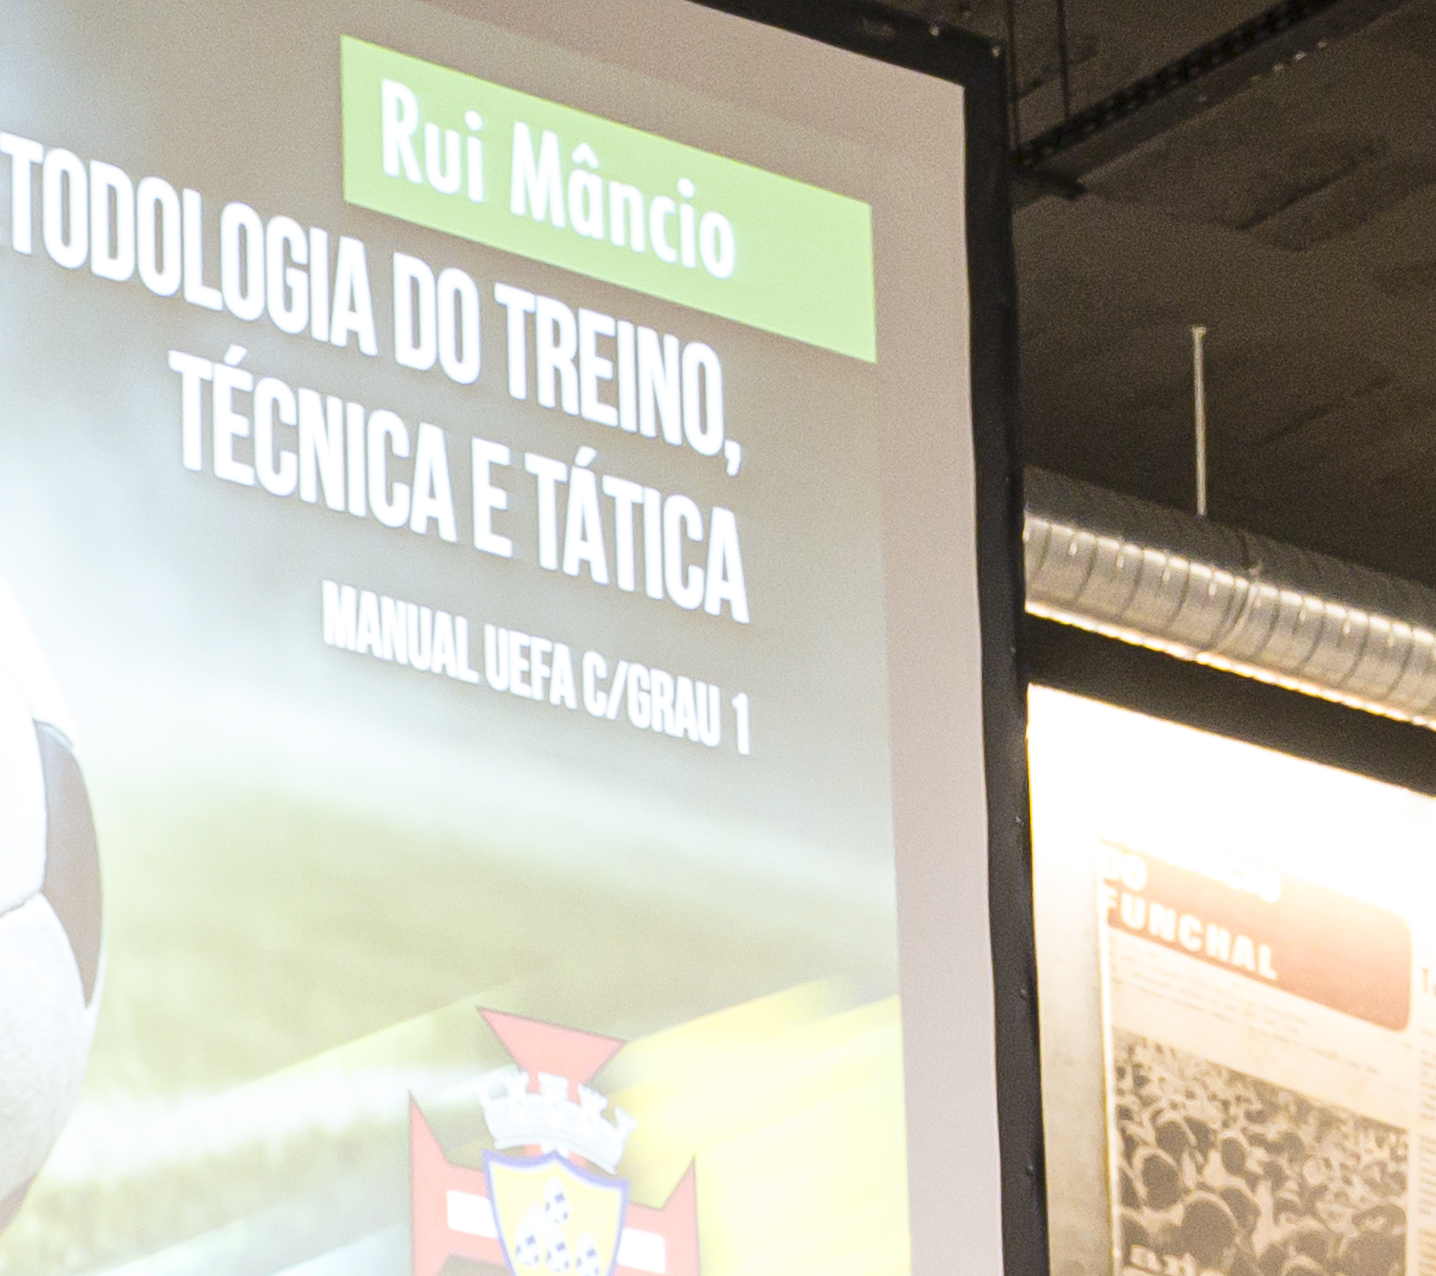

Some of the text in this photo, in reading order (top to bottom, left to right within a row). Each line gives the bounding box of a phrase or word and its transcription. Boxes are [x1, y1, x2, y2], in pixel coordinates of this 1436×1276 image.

[380, 78, 738, 281] Rui Mâncio
[391, 250, 482, 387] DO
[493, 280, 744, 478] TREINO,
[168, 343, 752, 625] TÉCNICA E TÁTICA
[321, 577, 753, 756] MANUAL UEFA C/GRAU 1
